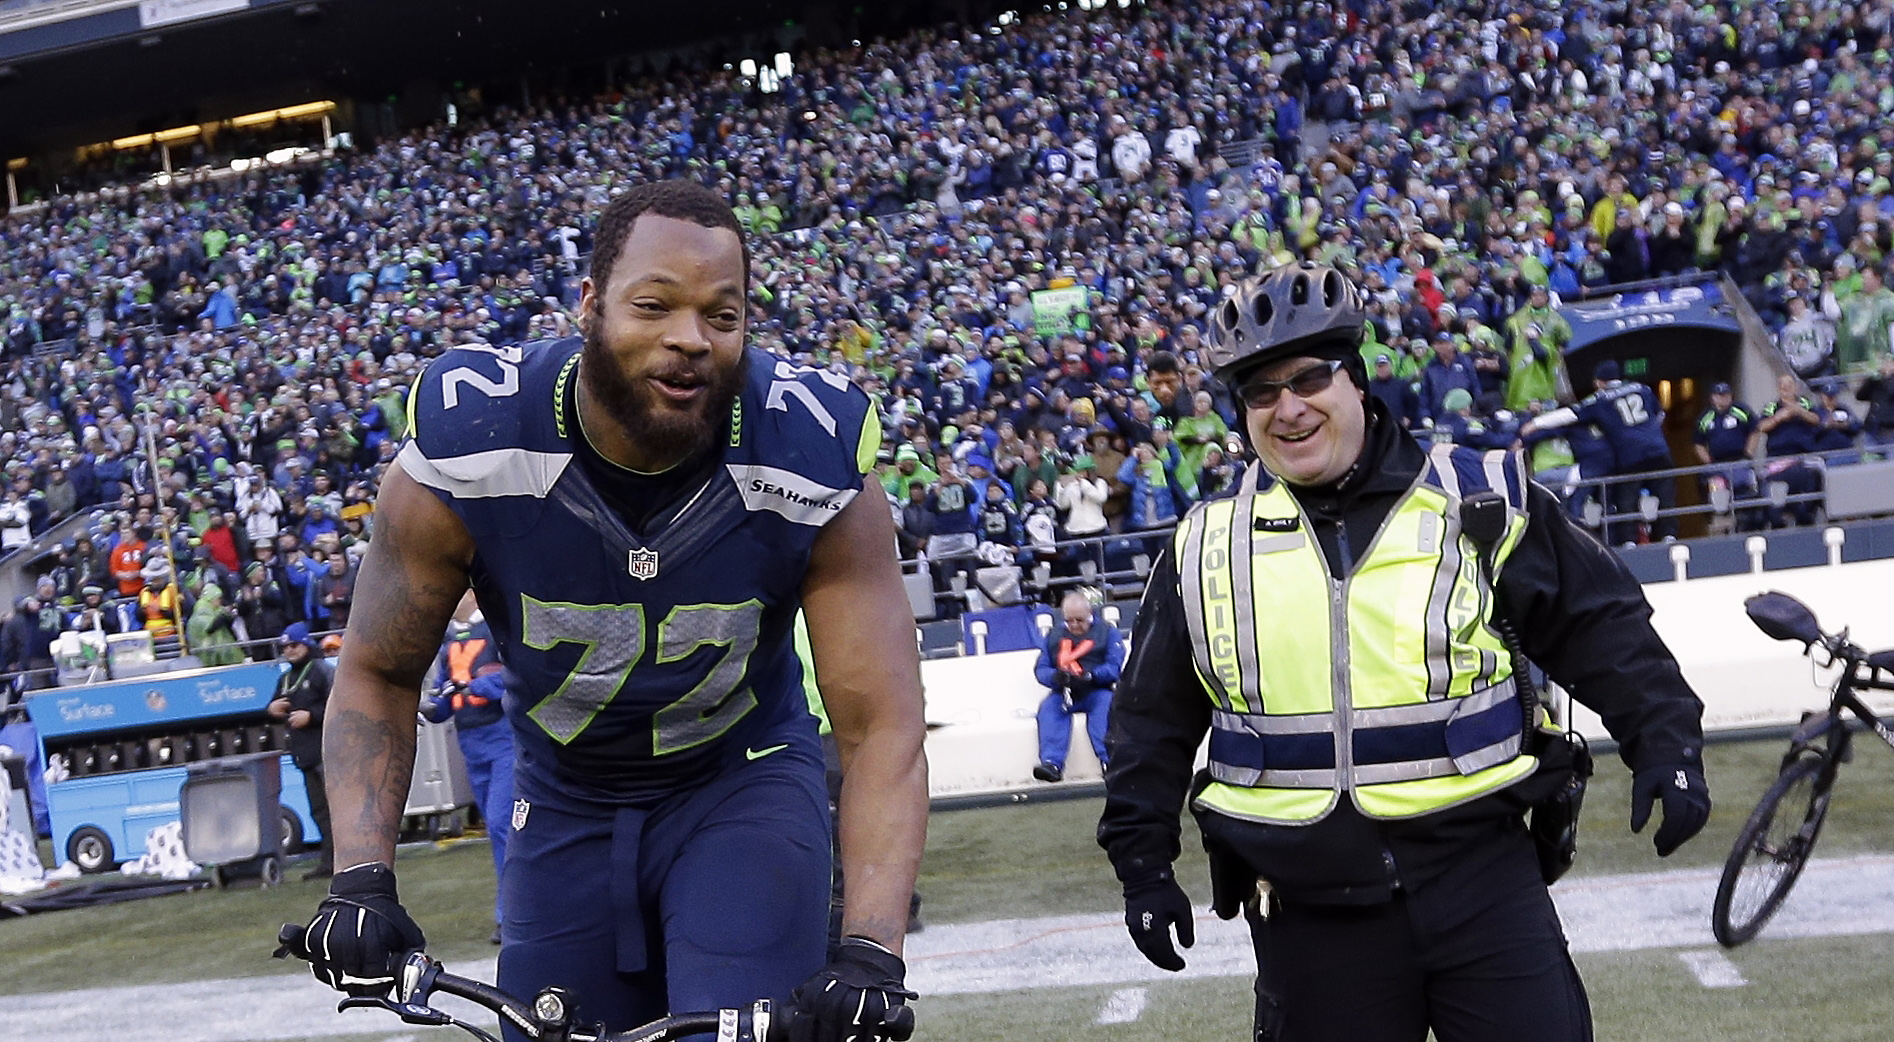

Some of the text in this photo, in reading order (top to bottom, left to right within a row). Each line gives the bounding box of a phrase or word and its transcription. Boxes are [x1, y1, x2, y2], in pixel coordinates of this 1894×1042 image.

[765, 361, 851, 437] 72
[1615, 393, 1650, 426] 12
[751, 479, 842, 511] SEAHAWKS
[1205, 526, 1238, 689] POLICE
[1454, 536, 1479, 670] OLIE
[520, 592, 766, 756] 72
[1057, 637, 1096, 677] K
